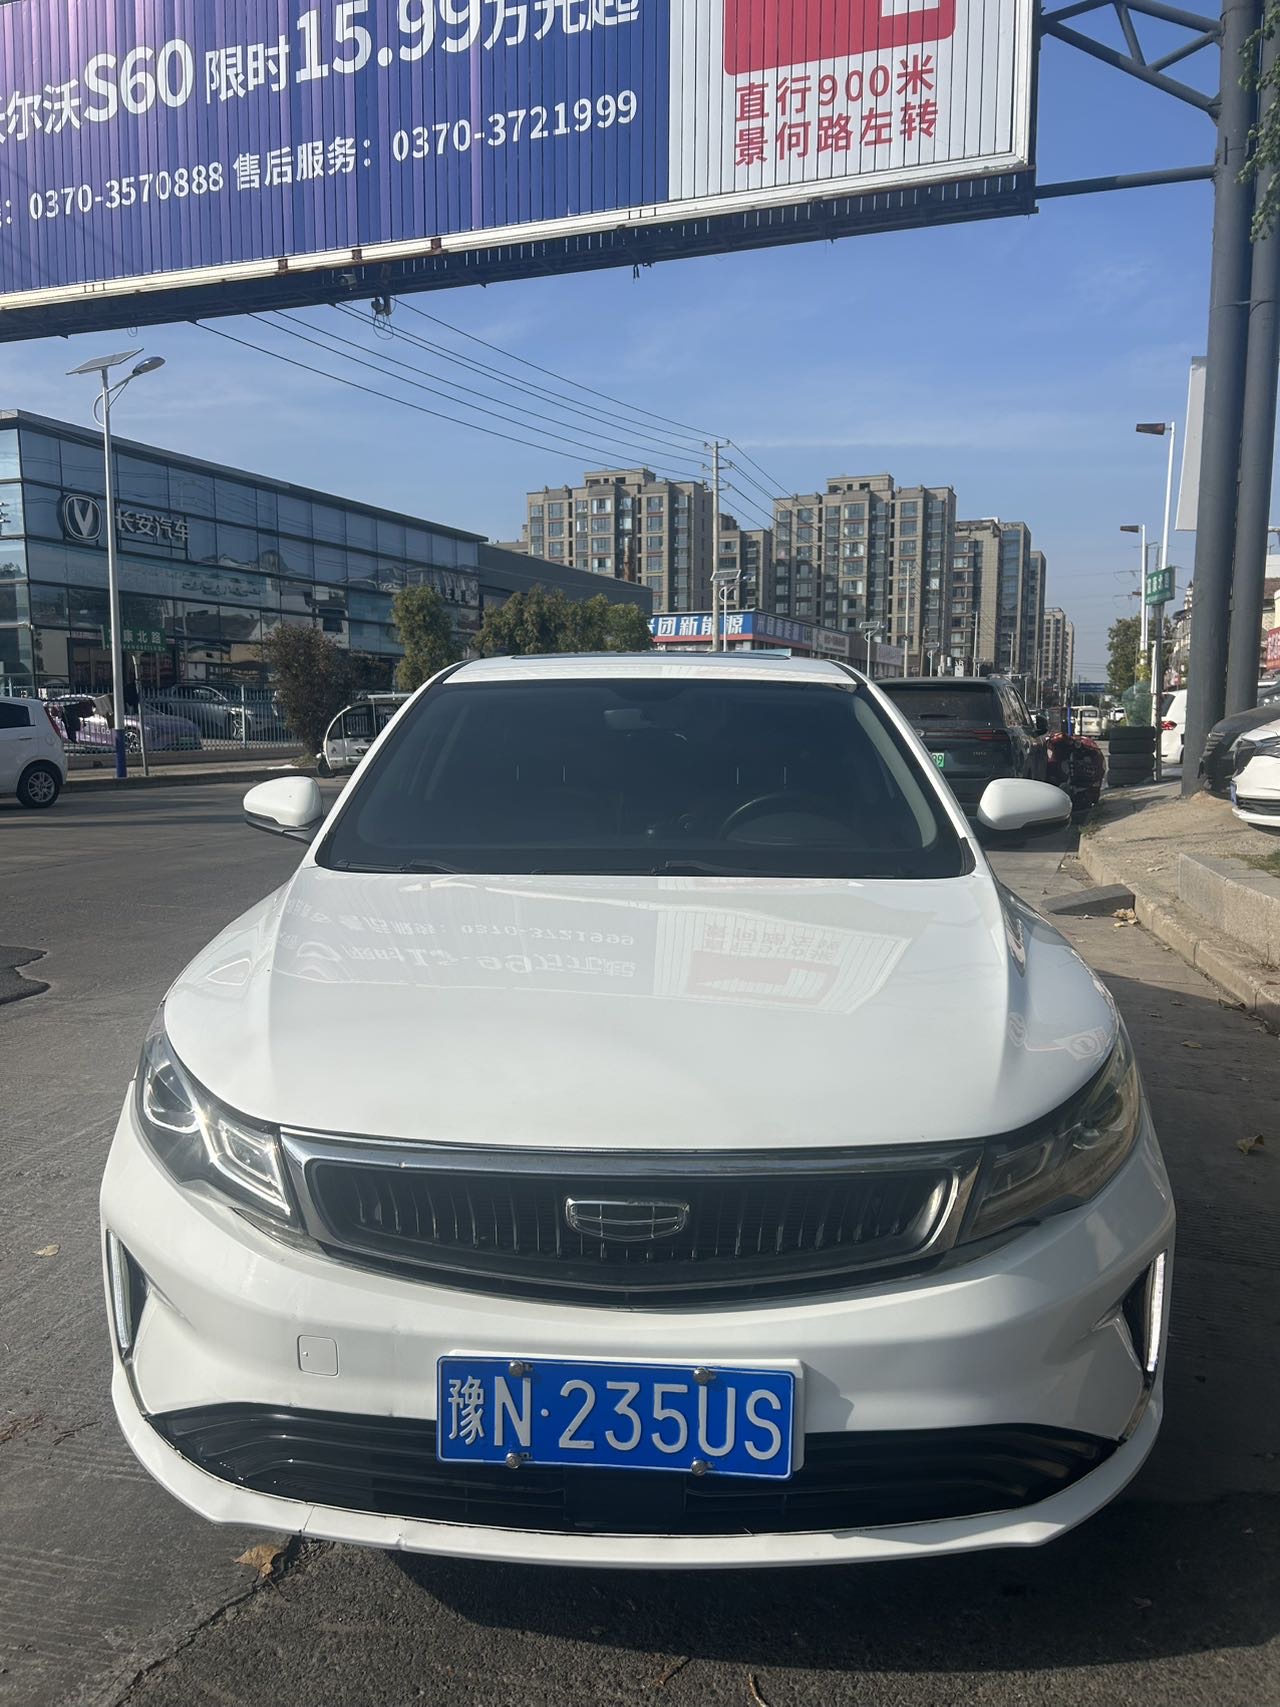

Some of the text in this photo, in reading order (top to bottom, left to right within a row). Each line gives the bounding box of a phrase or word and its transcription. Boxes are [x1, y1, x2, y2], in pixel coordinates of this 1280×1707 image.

[0, 38, 194, 145] 尔沃S60
[735, 54, 935, 122] 直行900米
[29, 162, 224, 220] 0370-3570888
[392, 89, 638, 163] 0370-3721999
[735, 98, 939, 166] 景何路左转
[115, 508, 190, 541] 长安汽车
[647, 614, 744, 637] 团新能源
[447, 1375, 783, 1461] 豫N·235US
